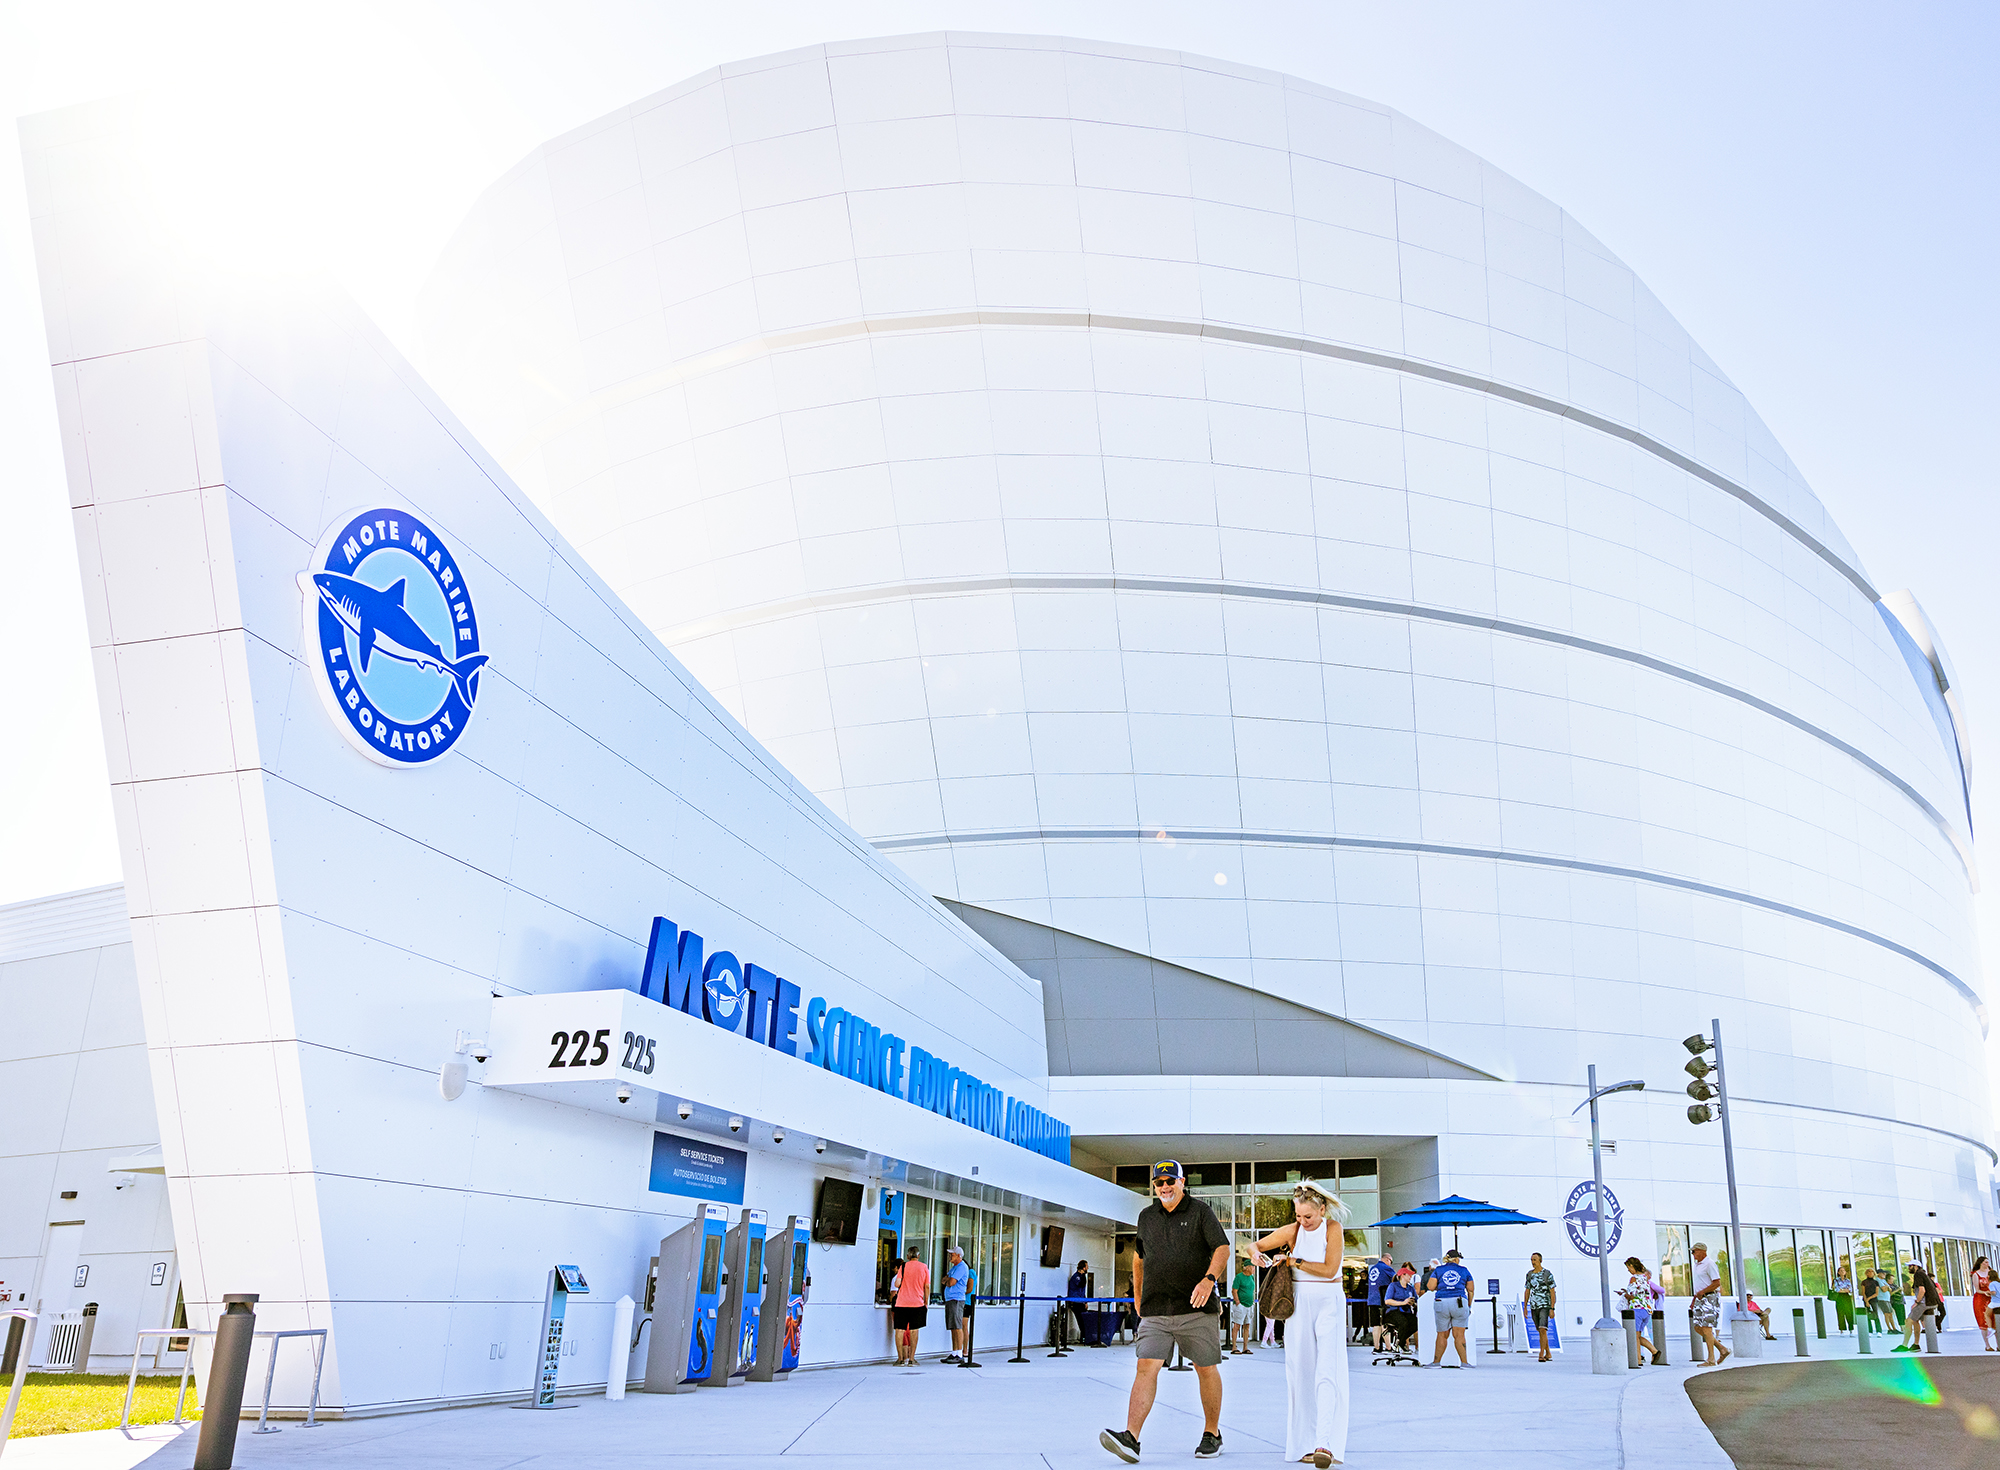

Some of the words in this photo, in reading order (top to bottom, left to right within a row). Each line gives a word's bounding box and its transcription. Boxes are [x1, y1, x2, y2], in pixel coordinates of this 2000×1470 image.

[342, 520, 400, 565] MOTE
[410, 530, 472, 642] MARINE
[329, 646, 455, 752] LABORATORY
[547, 1029, 611, 1068] 225
[621, 1031, 657, 1075] 225
[639, 916, 801, 1058] MOTE
[805, 996, 906, 1100] SCIENCE
[907, 1045, 1004, 1139] EDUCATION
[1004, 1096, 1071, 1167] AQUARIUM
[680, 1148, 691, 1158] SELF
[690, 1150, 708, 1162] SERVICE
[707, 1154, 725, 1165] TICKETS
[672, 1168, 704, 1181] AUTOSERVICIO
[704, 1174, 710, 1182] DE
[710, 1175, 727, 1186] BOLETOS
[1569, 1185, 1587, 1207] MOTE
[1590, 1183, 1619, 1209] MRINE
[1572, 1232, 1618, 1255] LABORORY
